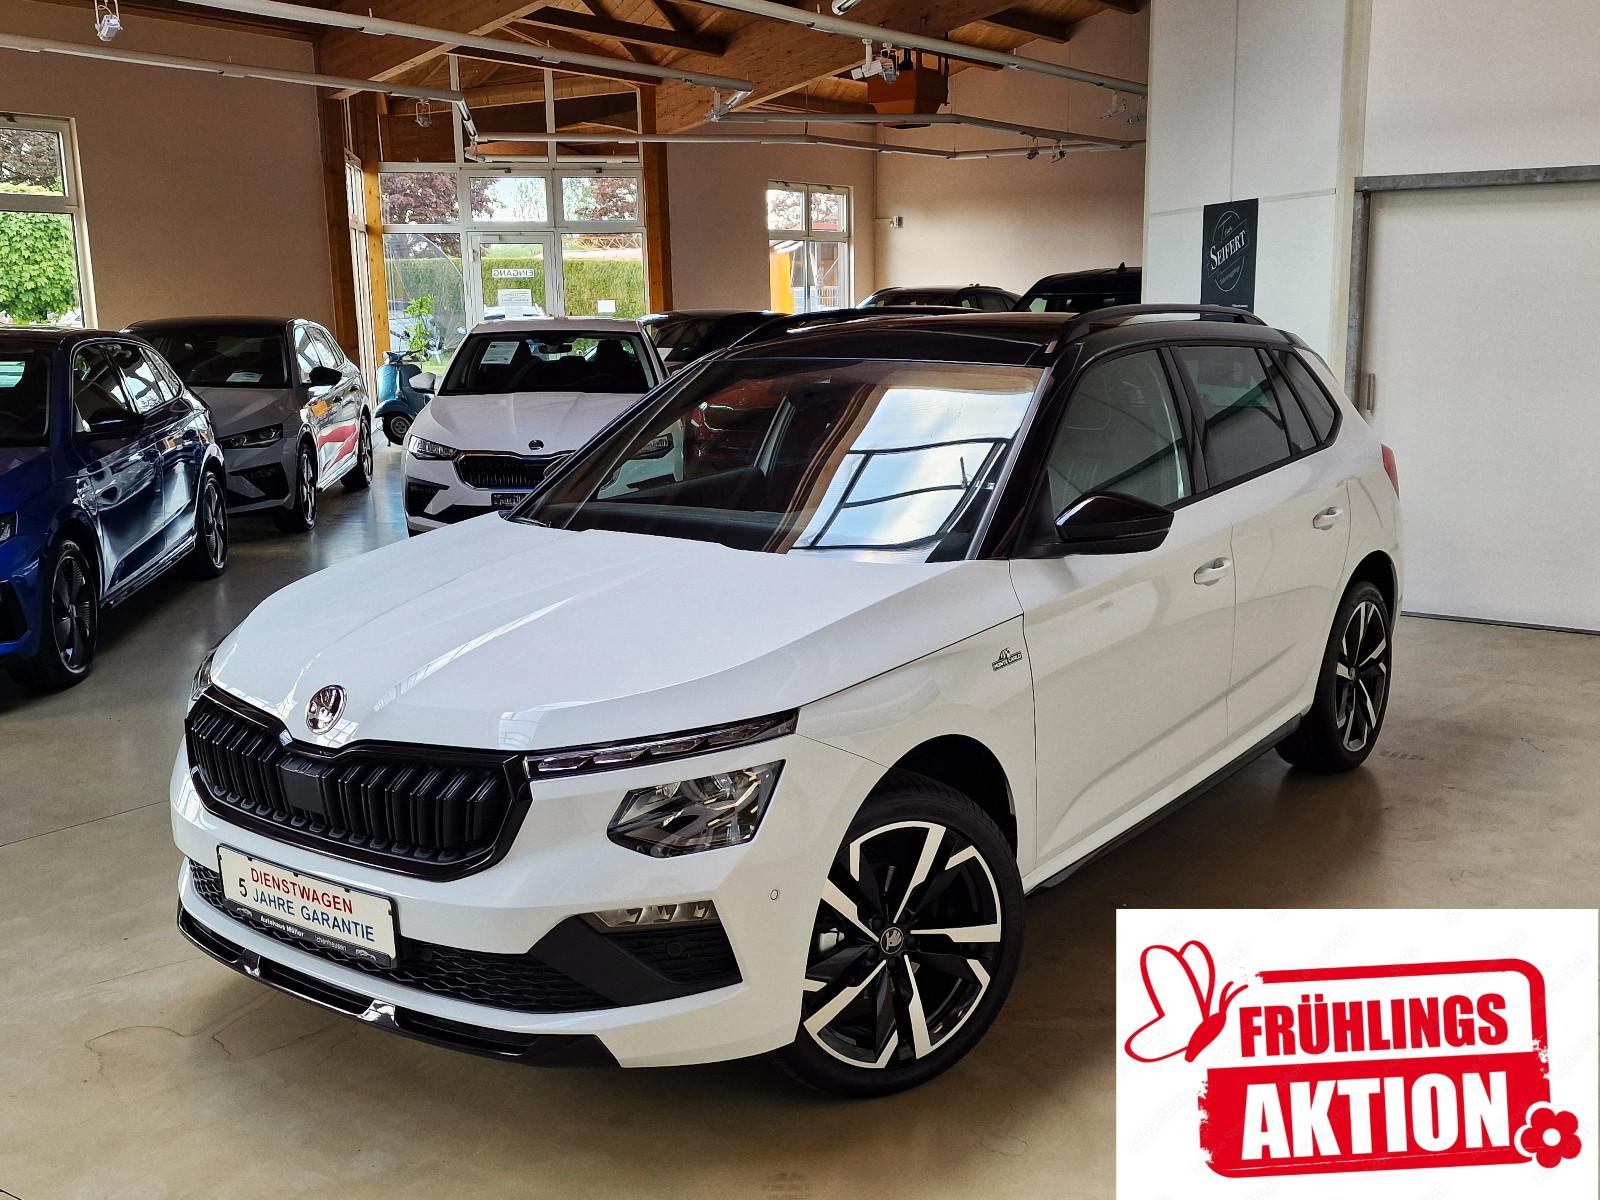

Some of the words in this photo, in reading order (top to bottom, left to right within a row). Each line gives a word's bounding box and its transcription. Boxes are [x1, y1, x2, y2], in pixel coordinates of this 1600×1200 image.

[1210, 230, 1246, 270] SEIFERT
[238, 877, 248, 898] 5
[252, 888, 295, 916] JAHRE
[300, 905, 376, 942] GARANTIE
[250, 867, 353, 914] DIENSTWAGEN
